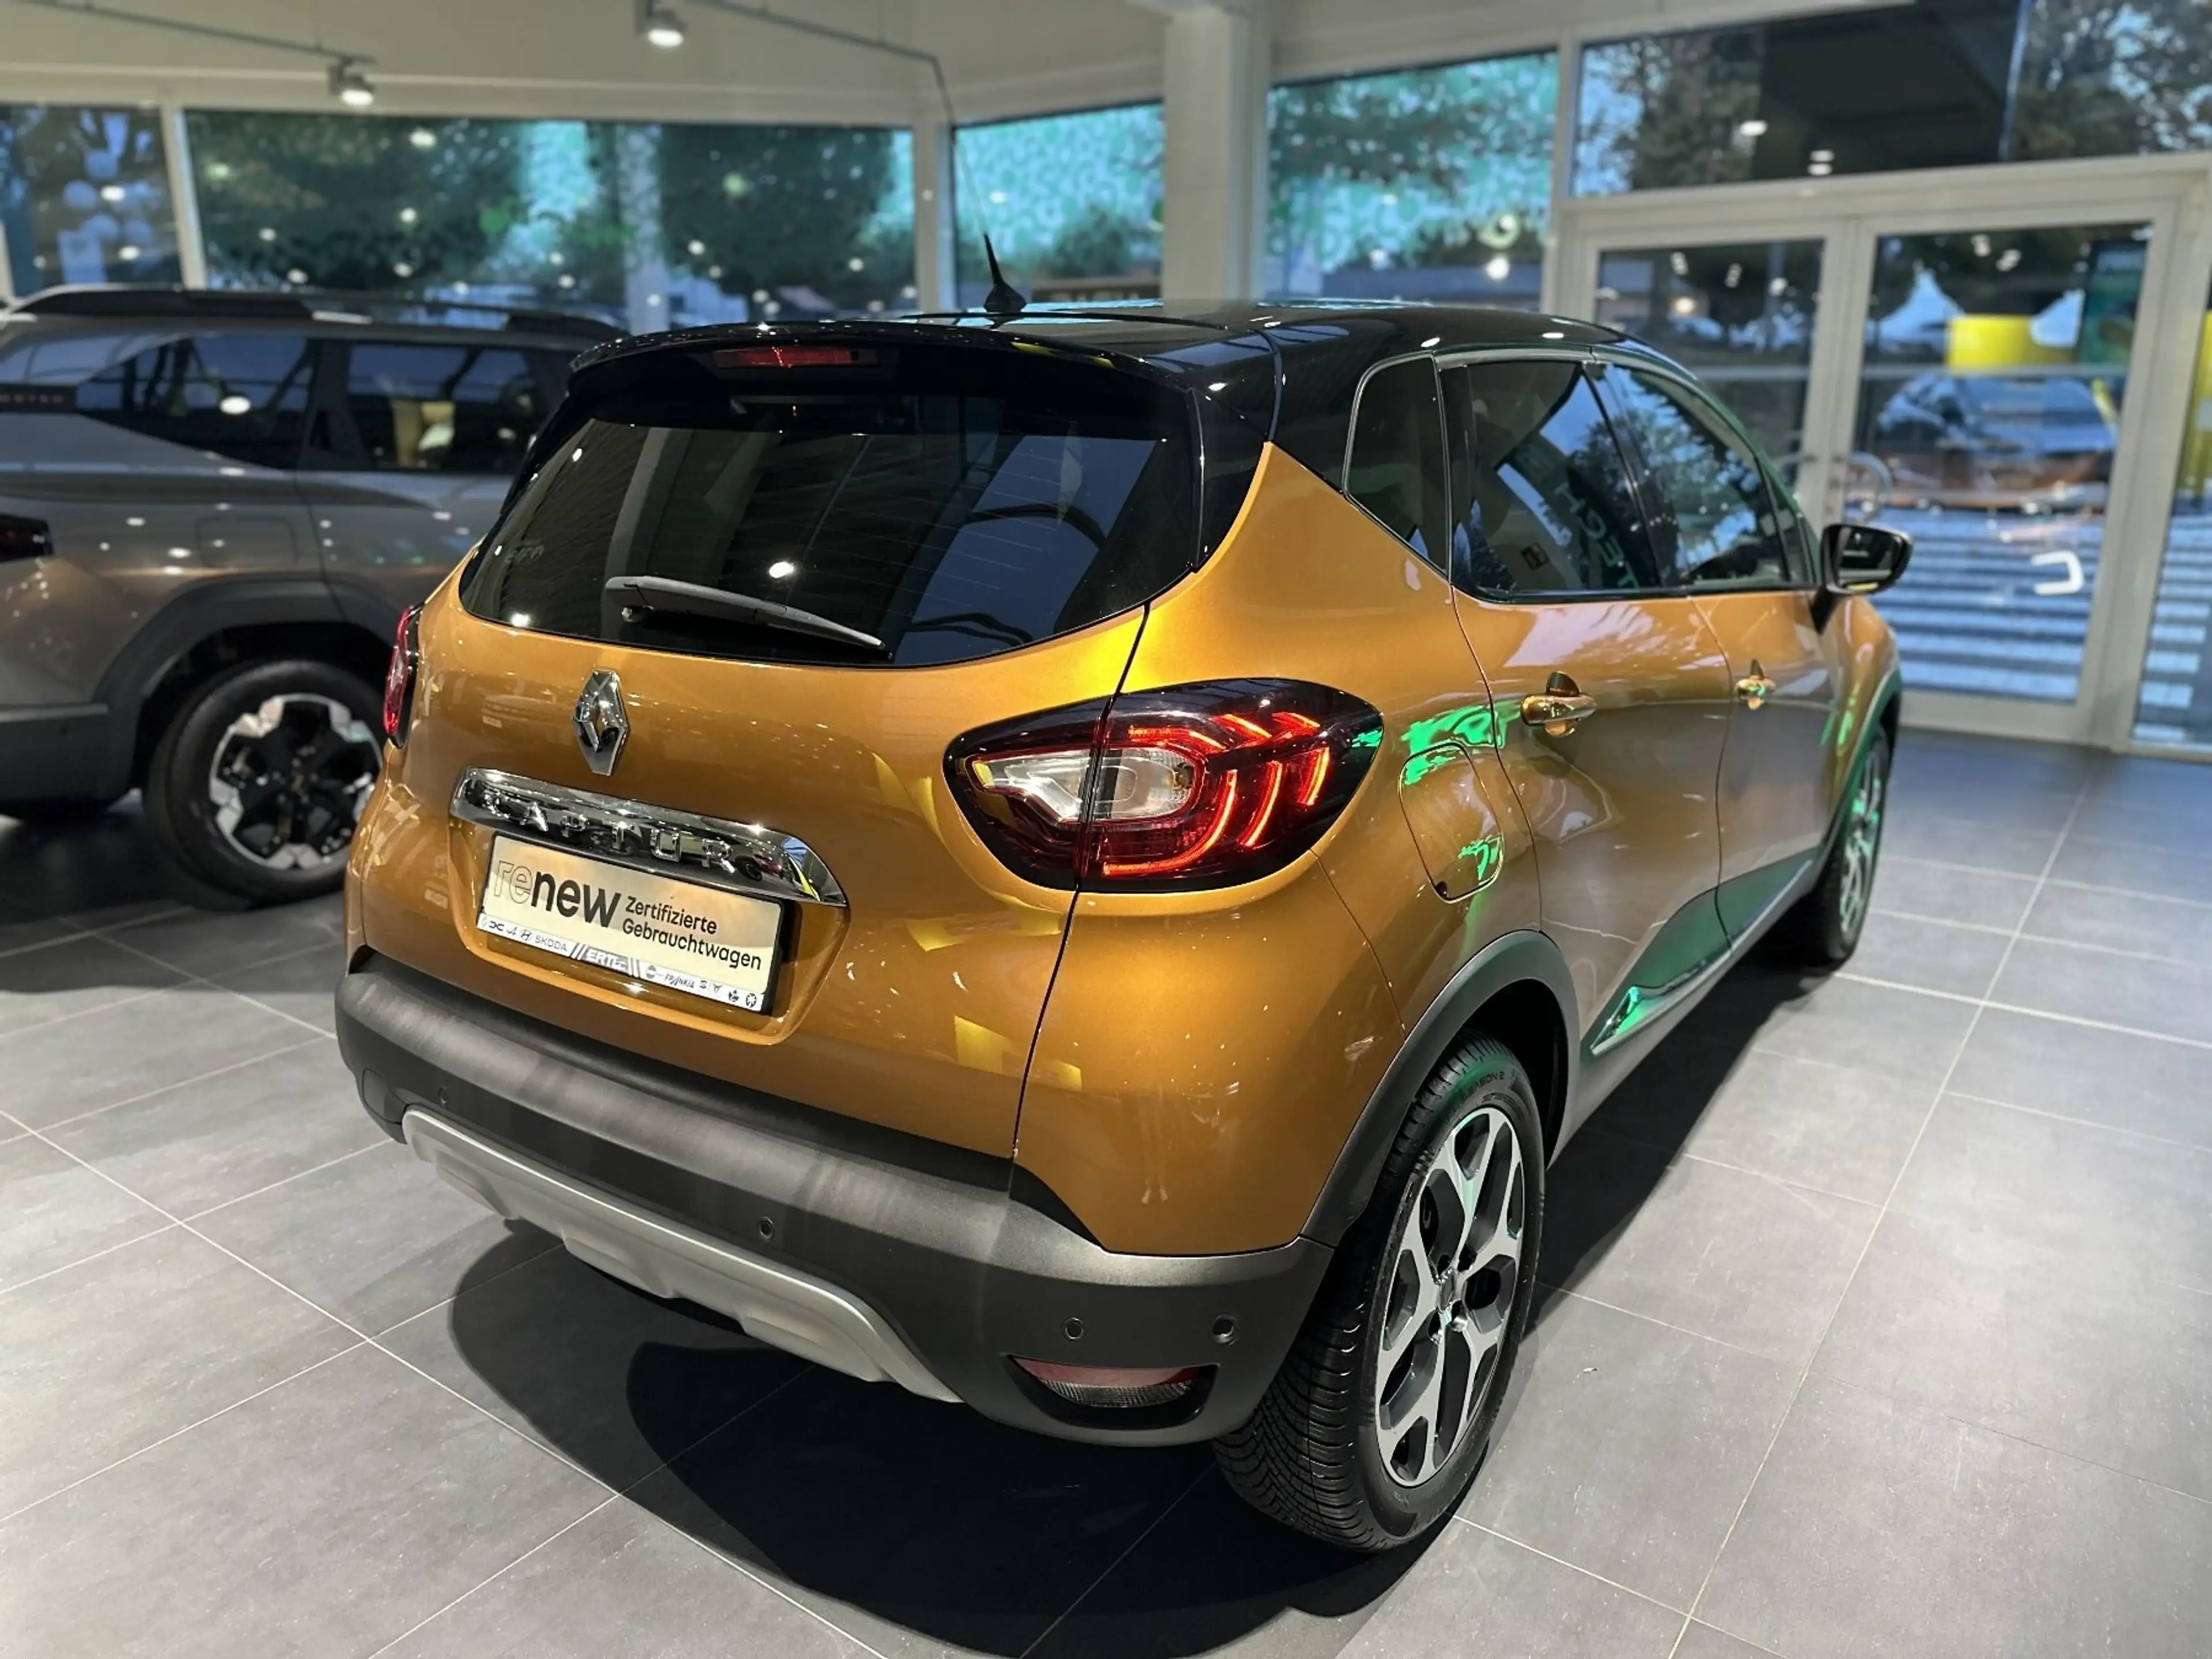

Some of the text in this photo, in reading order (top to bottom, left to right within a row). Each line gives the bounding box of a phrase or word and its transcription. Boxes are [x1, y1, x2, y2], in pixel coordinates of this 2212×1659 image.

[483, 790, 736, 874] CAPTUR
[493, 860, 622, 928] renew
[625, 896, 718, 935] Zertifizierte
[622, 918, 762, 971] Gebrauchtwagen
